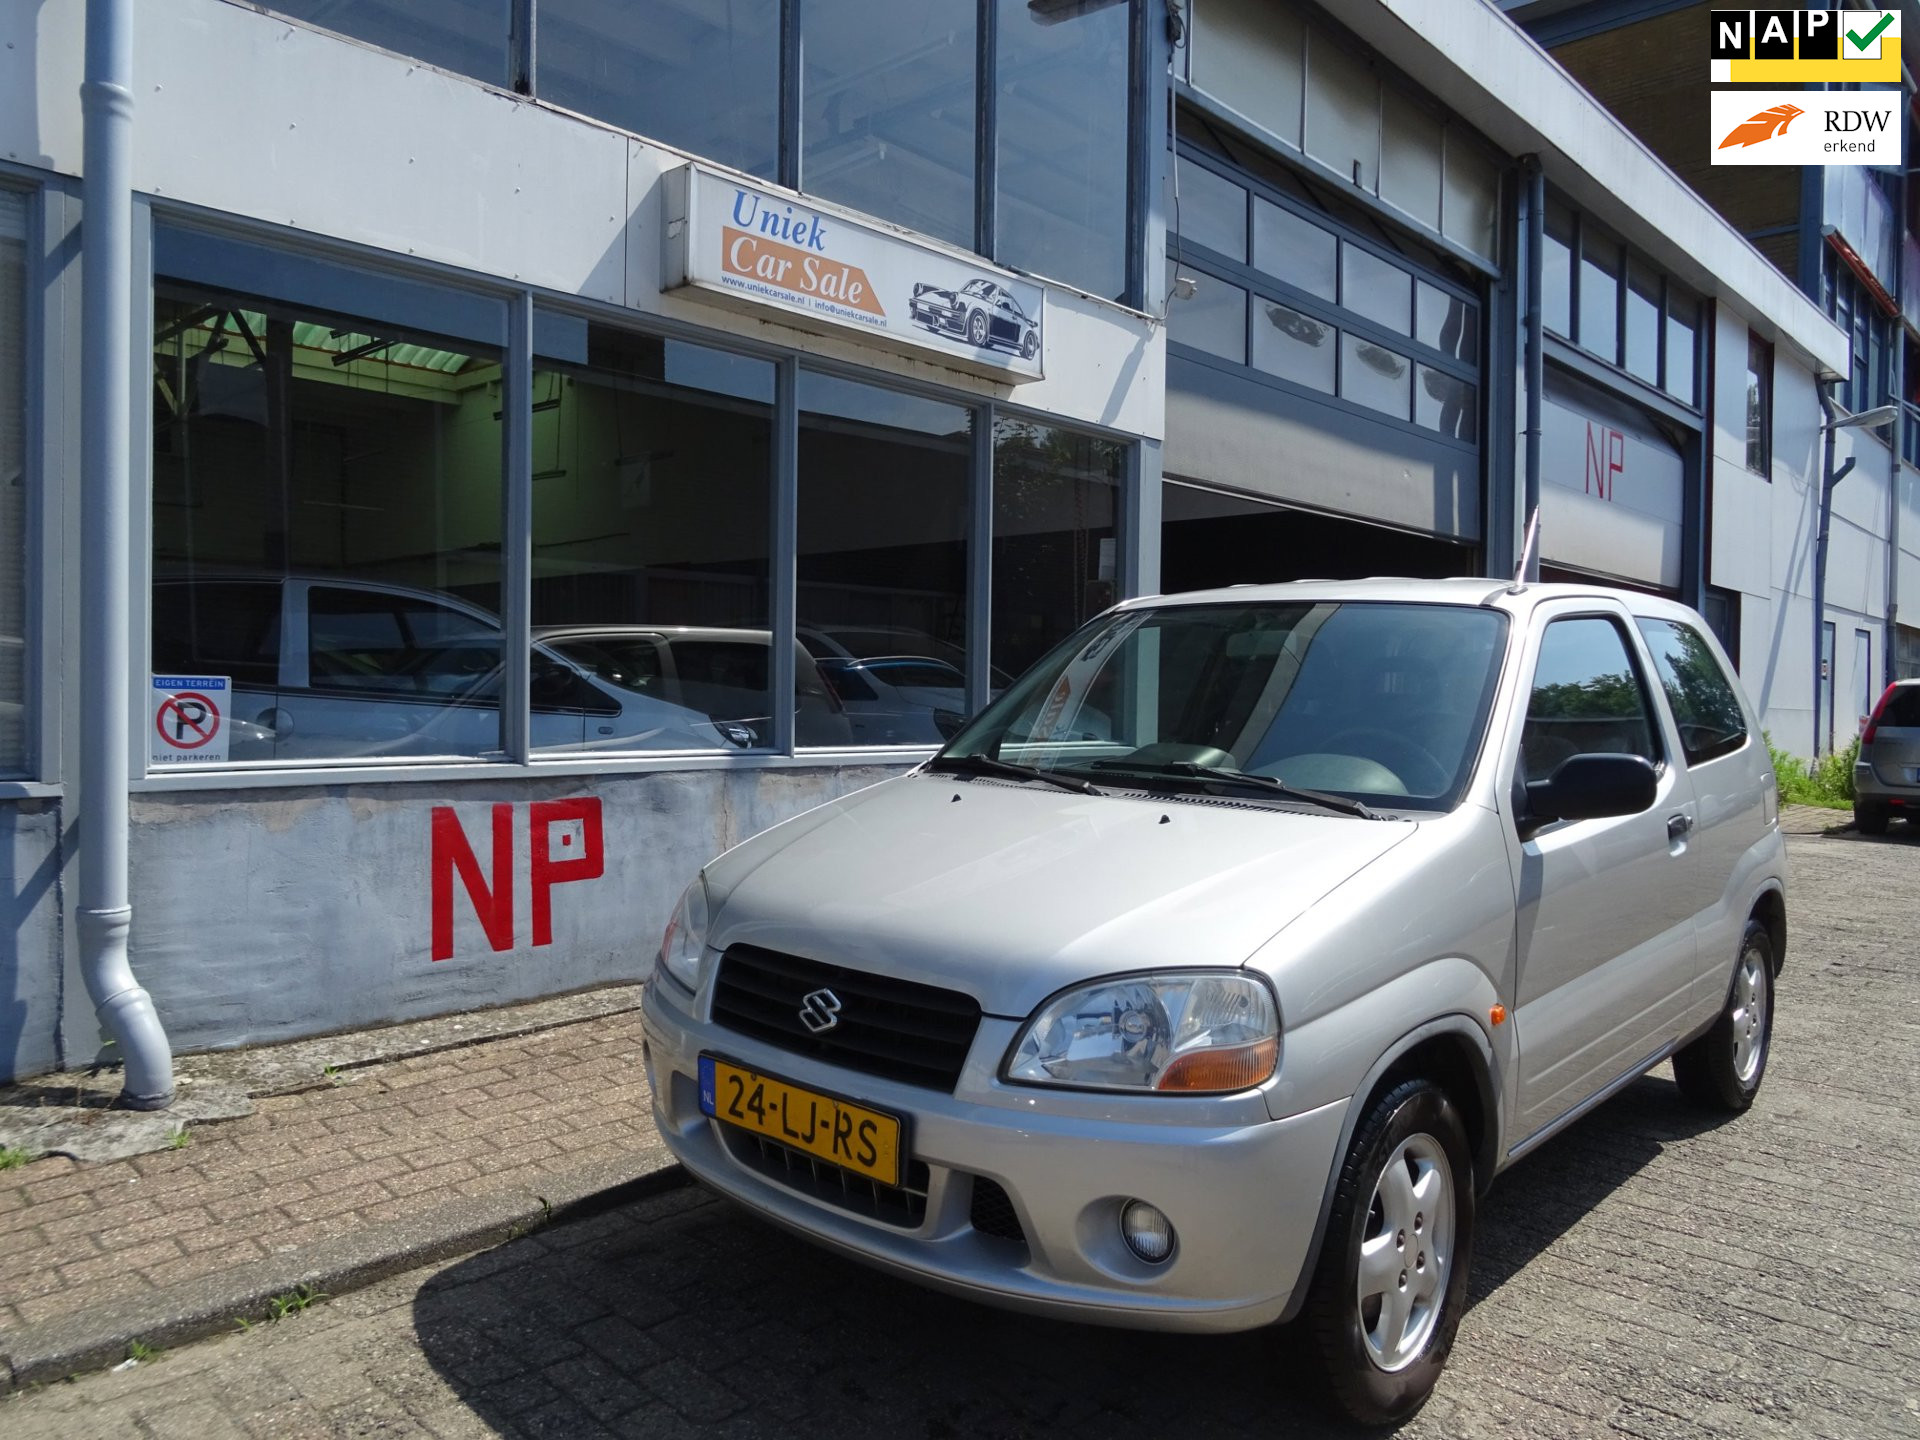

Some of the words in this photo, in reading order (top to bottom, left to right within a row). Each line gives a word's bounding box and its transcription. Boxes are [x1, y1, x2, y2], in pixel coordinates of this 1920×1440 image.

[732, 189, 827, 251] Uniek
[721, 275, 805, 305] www.uniekcarsale.nl
[814, 299, 888, 328] info@uniekcarsale.nl
[730, 236, 792, 282] Car
[799, 257, 864, 305] Sale
[1585, 421, 1624, 502] NP
[155, 679, 183, 687] EIGEN
[185, 679, 224, 688] TERREIN
[152, 754, 173, 762] niet
[176, 754, 221, 762] parkeren
[431, 796, 604, 963] NP
[703, 1089, 714, 1105] NL
[728, 1074, 878, 1168] 24-LJ-RS
